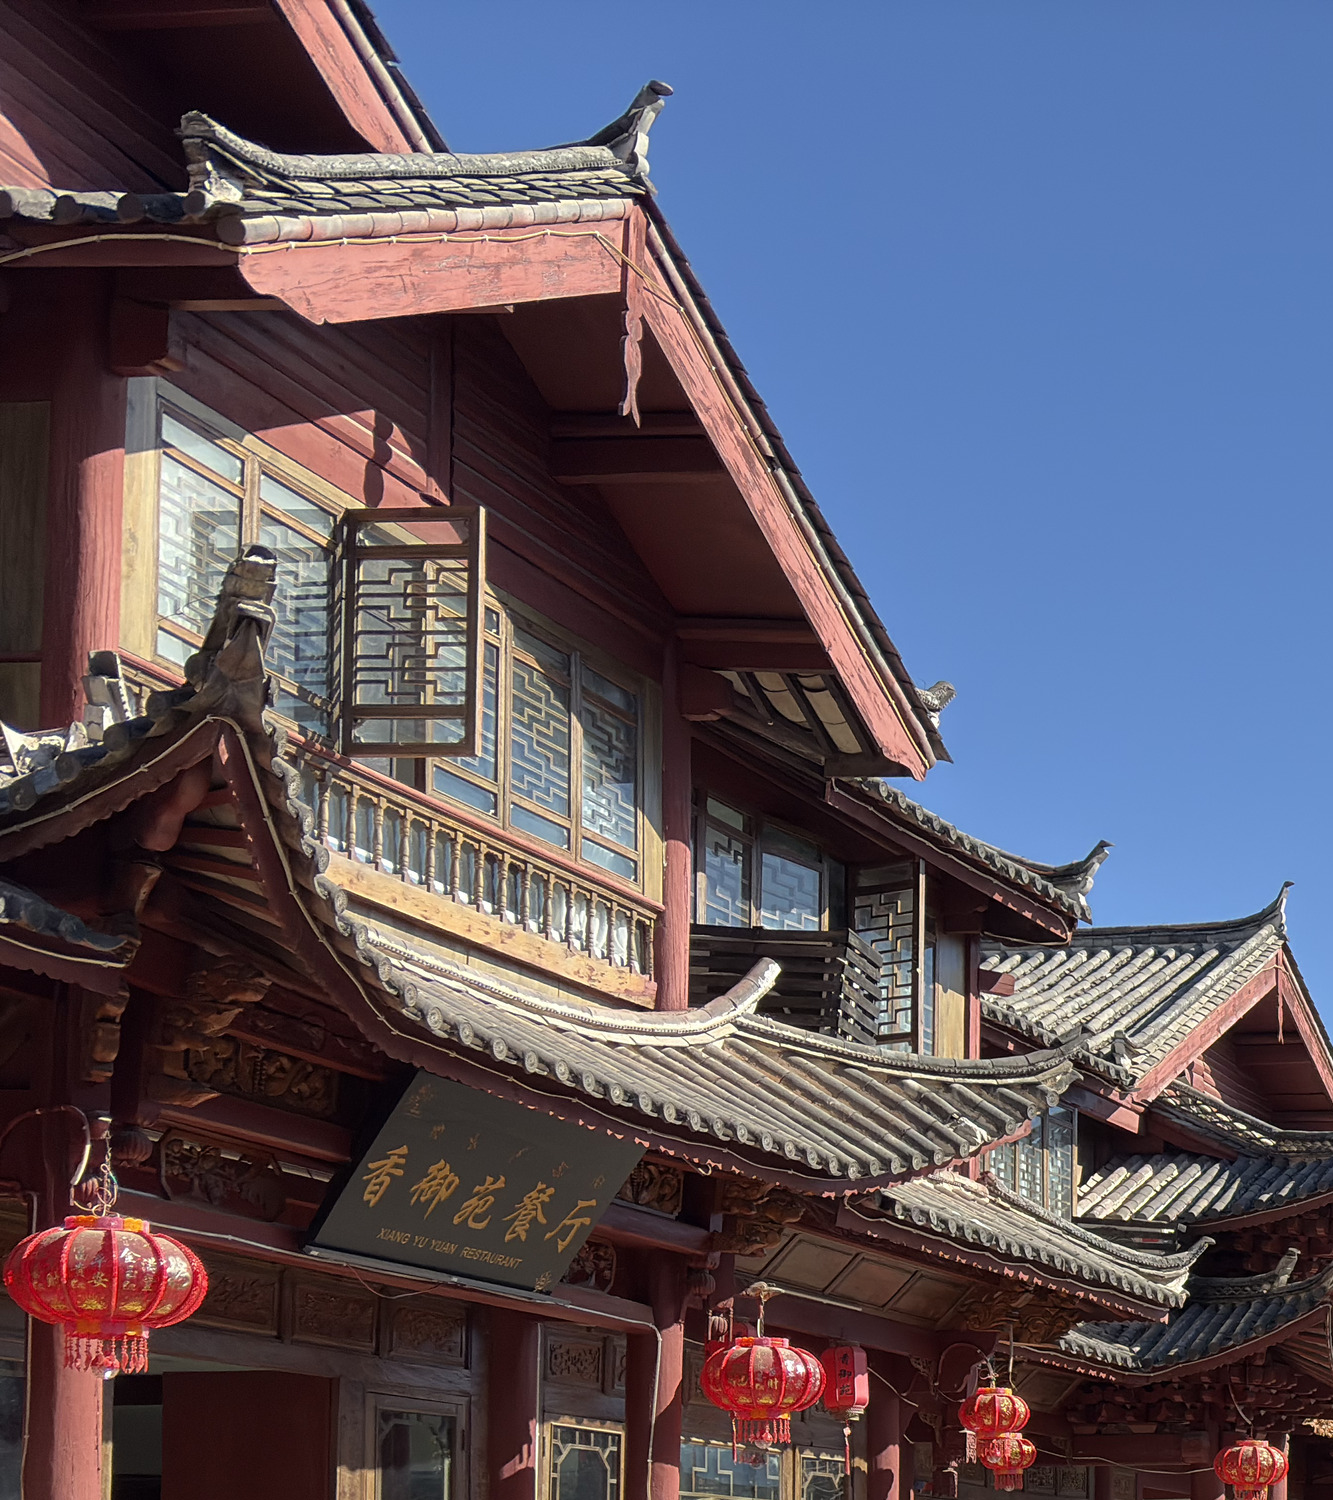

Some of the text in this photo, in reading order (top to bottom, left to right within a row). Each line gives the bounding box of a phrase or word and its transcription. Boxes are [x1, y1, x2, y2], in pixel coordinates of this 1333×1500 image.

[362, 1144, 597, 1253] 香御苑餐厅
[376, 1227, 523, 1270] XIANG YU YUAN RESTAURANT
